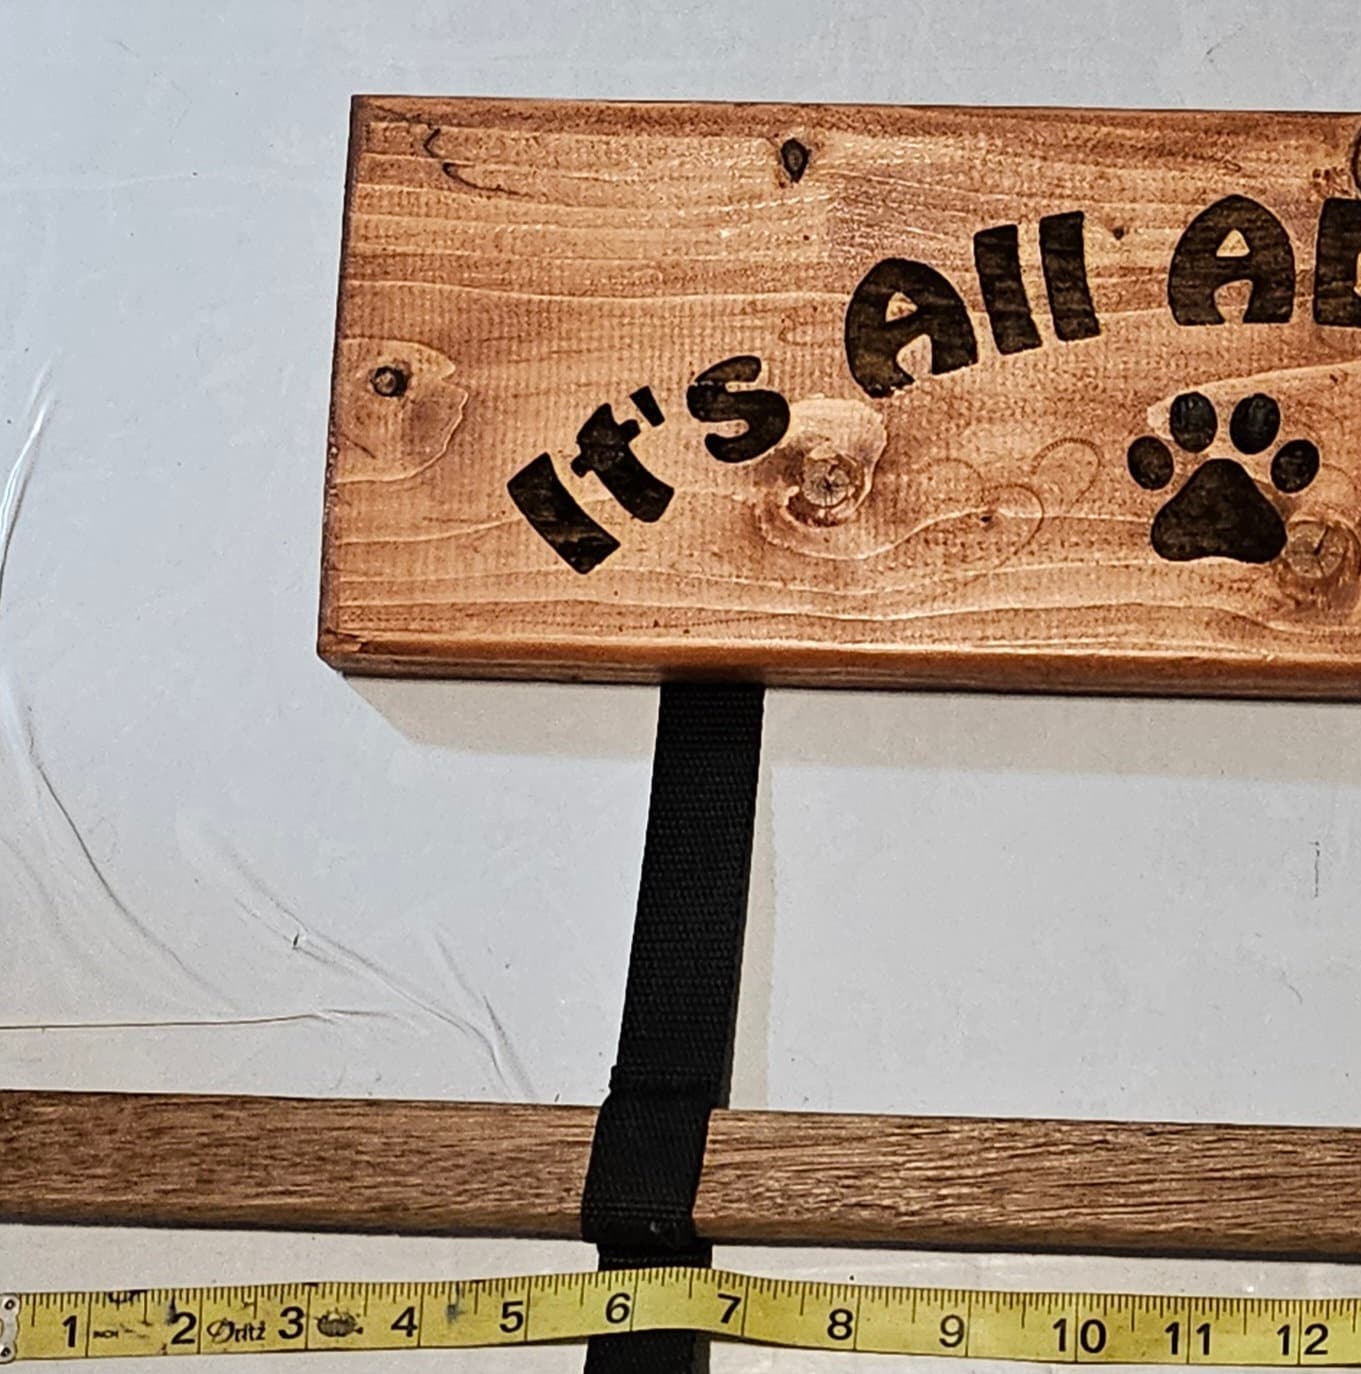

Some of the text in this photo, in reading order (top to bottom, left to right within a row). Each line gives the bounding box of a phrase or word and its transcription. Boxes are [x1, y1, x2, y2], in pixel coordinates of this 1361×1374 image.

[506, 355, 791, 575] It's
[844, 210, 1102, 397] All
[62, 1318, 78, 1349] 1
[170, 1311, 196, 1345] 2
[278, 1306, 304, 1339] 3
[391, 1306, 417, 1338] 4
[499, 1300, 524, 1334] 5
[605, 1293, 630, 1324] 6
[716, 1294, 742, 1325] 7
[827, 1307, 853, 1341] 8
[939, 1314, 965, 1349] 9
[1052, 1318, 1107, 1354] 10
[1164, 1321, 1212, 1357] 11
[1276, 1323, 1329, 1356] 12
